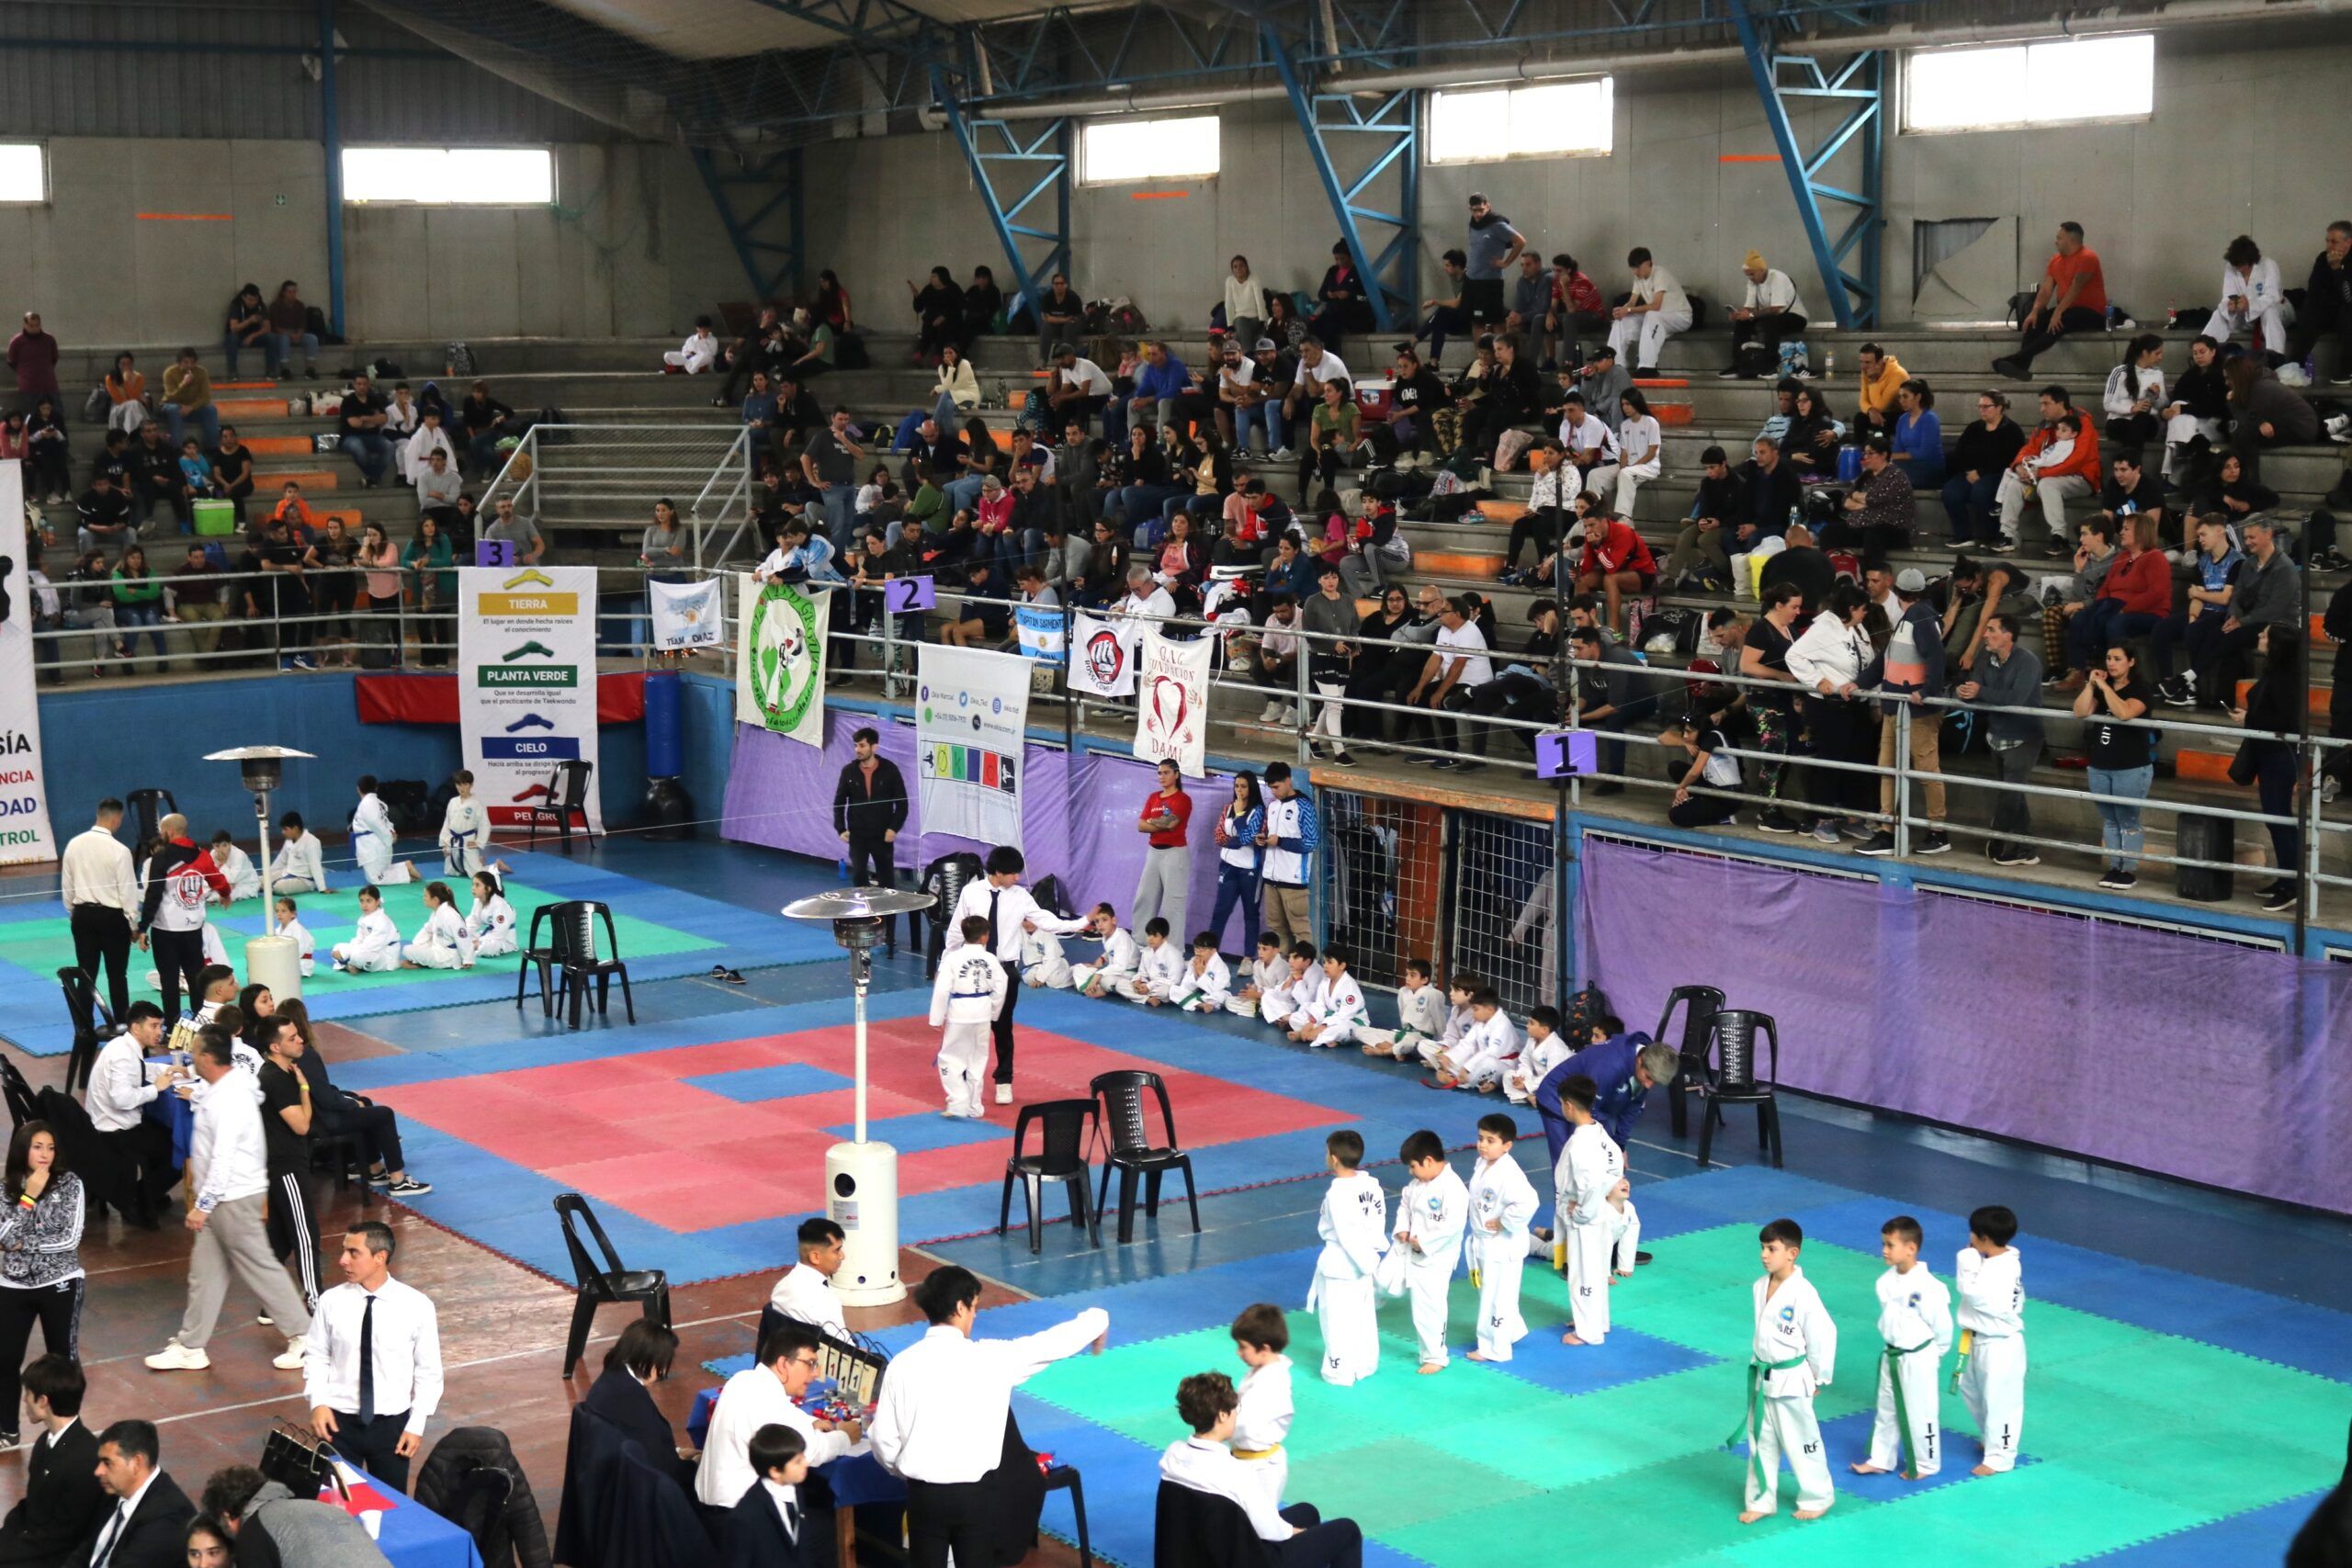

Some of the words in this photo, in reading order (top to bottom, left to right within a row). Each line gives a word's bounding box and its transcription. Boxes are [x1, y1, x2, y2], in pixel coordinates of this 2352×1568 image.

[487, 541, 503, 567] 3
[900, 579, 922, 610] 2
[508, 598, 548, 610] TIERRA
[1040, 617, 1065, 629] SARMIENT
[666, 637, 685, 646] TEAM
[487, 671, 531, 682] PLANTA
[532, 671, 569, 682] VERDE
[514, 742, 548, 753] CIELO
[1151, 738, 1182, 763] DAMI
[1554, 736, 1578, 774] 1
[514, 811, 559, 821] PELGR
[841, 1376, 847, 1390] 1
[853, 1374, 859, 1389] 1
[2001, 1424, 2011, 1450] IT
